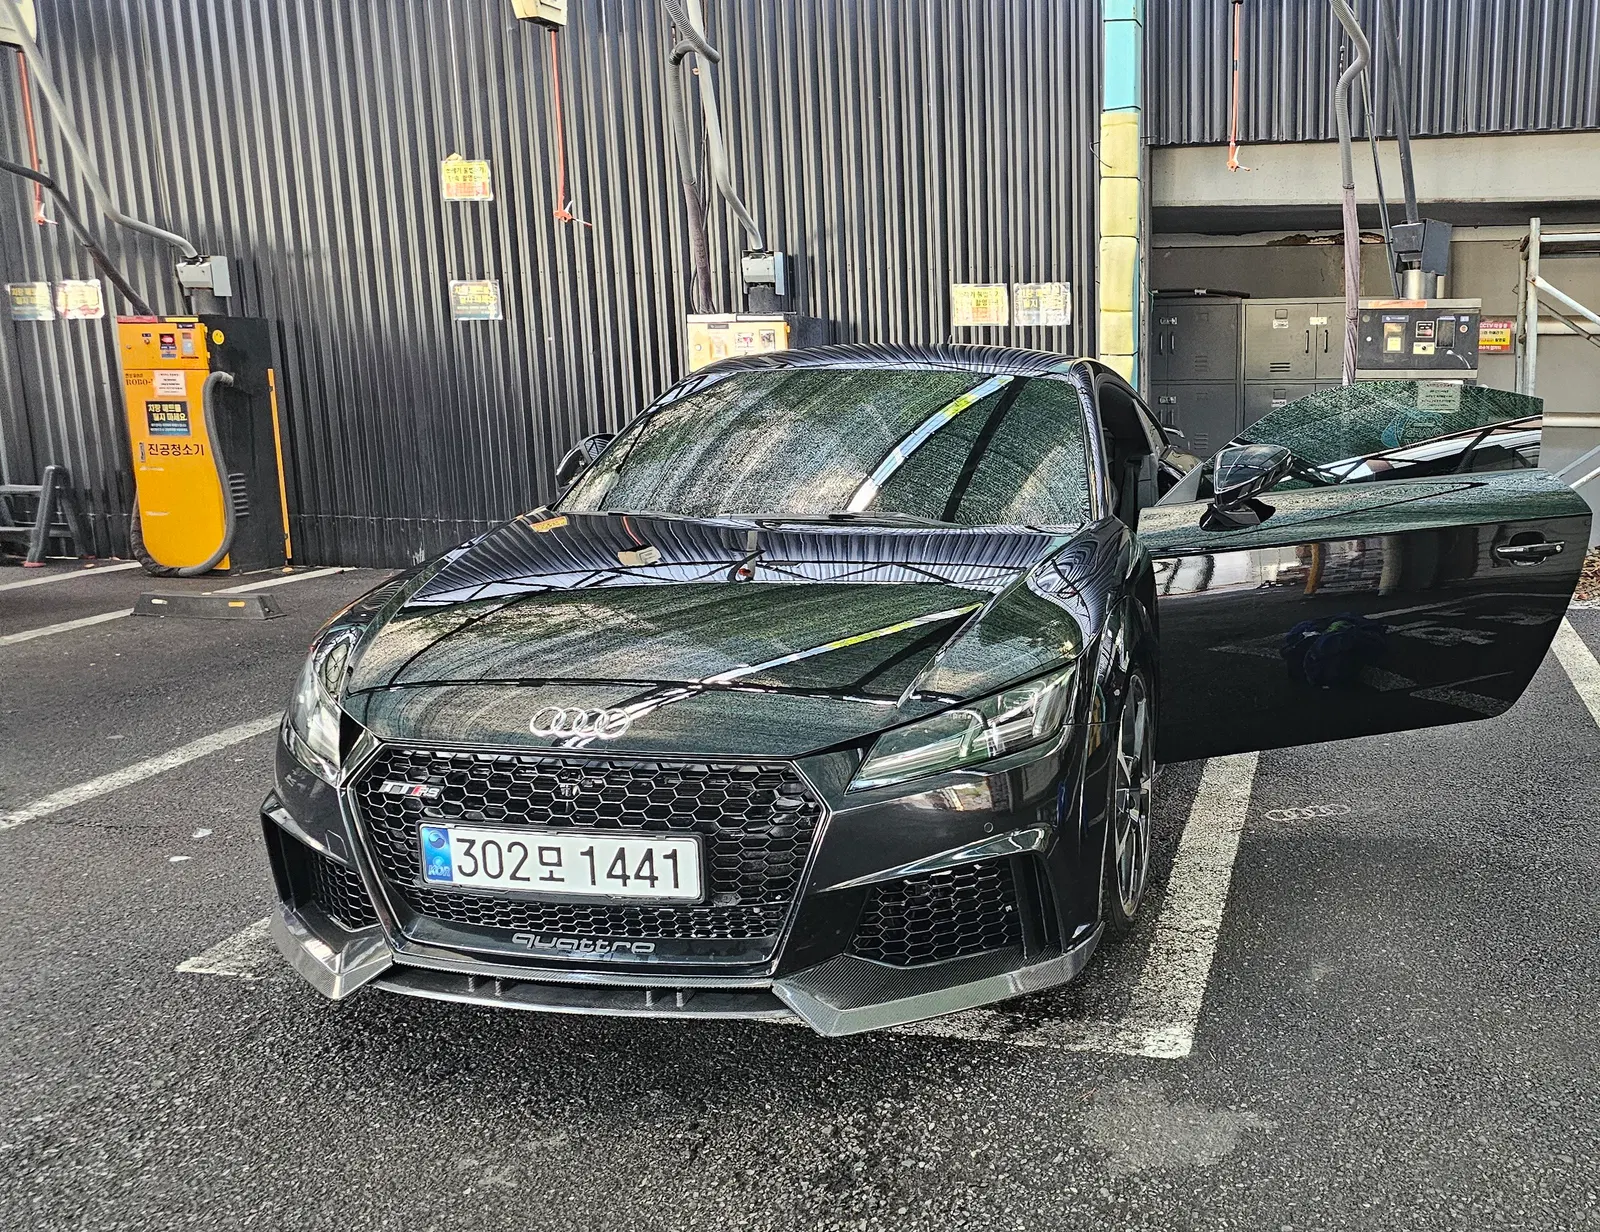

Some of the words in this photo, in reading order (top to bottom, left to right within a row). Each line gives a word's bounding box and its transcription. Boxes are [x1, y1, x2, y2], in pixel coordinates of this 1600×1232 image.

[147, 443, 205, 456] 진공청소기
[428, 864, 451, 877] KOR
[455, 837, 565, 883] 302모
[579, 845, 681, 889] 1441
[511, 932, 656, 954] quattro
